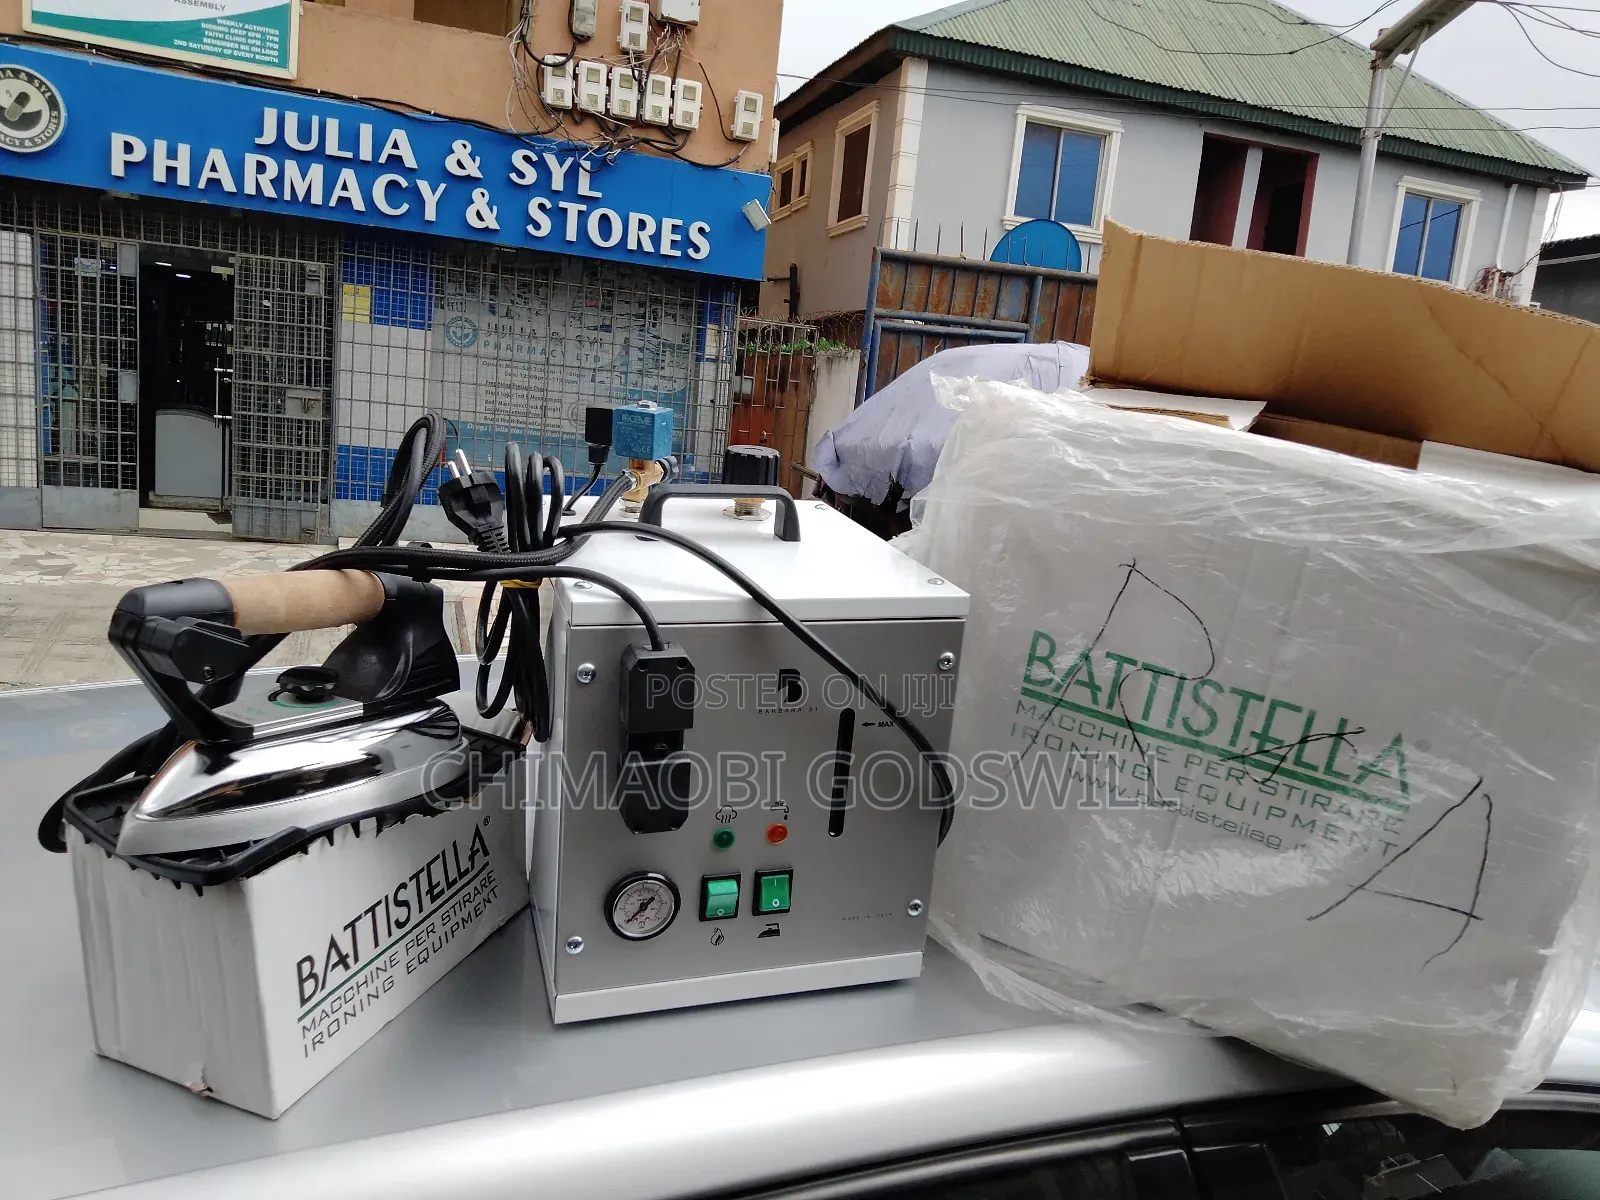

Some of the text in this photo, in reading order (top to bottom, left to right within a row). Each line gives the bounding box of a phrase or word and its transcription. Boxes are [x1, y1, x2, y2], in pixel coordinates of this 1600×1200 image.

[201, 22, 229, 33] DIGGING
[230, 27, 247, 36] DEEP
[266, 34, 279, 42] 7PM
[205, 30, 224, 39] FAITH
[225, 34, 246, 43] CLINIC
[266, 41, 279, 49] 7PM
[217, 18, 279, 35] WEEKLY ACTIVITIES
[173, 39, 188, 47] 2ND
[188, 41, 222, 54] SATURDAY
[233, 50, 255, 59] EVERY
[255, 54, 279, 63] MONTH
[203, 37, 239, 49] REMEMBER
[261, 48, 279, 56] LORD
[19, 71, 28, 81] &
[32, 79, 52, 100] SYL
[24, 139, 33, 147] &
[33, 110, 59, 144] STORES
[254, 106, 603, 198] JULIA & SYL
[109, 131, 712, 261] PHARMACY & STORES
[483, 340, 601, 364] PHARMACY LTD
[467, 423, 488, 432] Dugs
[1022, 629, 1411, 803] BATTISTELLA
[1016, 699, 1173, 764] MACCHINE
[1184, 752, 1246, 787] PER
[1258, 776, 1405, 836] STIRARE
[1010, 722, 1150, 782] IRONING
[1174, 775, 1398, 858] EQUIPMENT
[295, 823, 490, 1010] BATTISTELLA
[302, 868, 497, 1040] MACCHINE PER STIRARE
[303, 885, 499, 1059] IRONING EQUIPMENT
